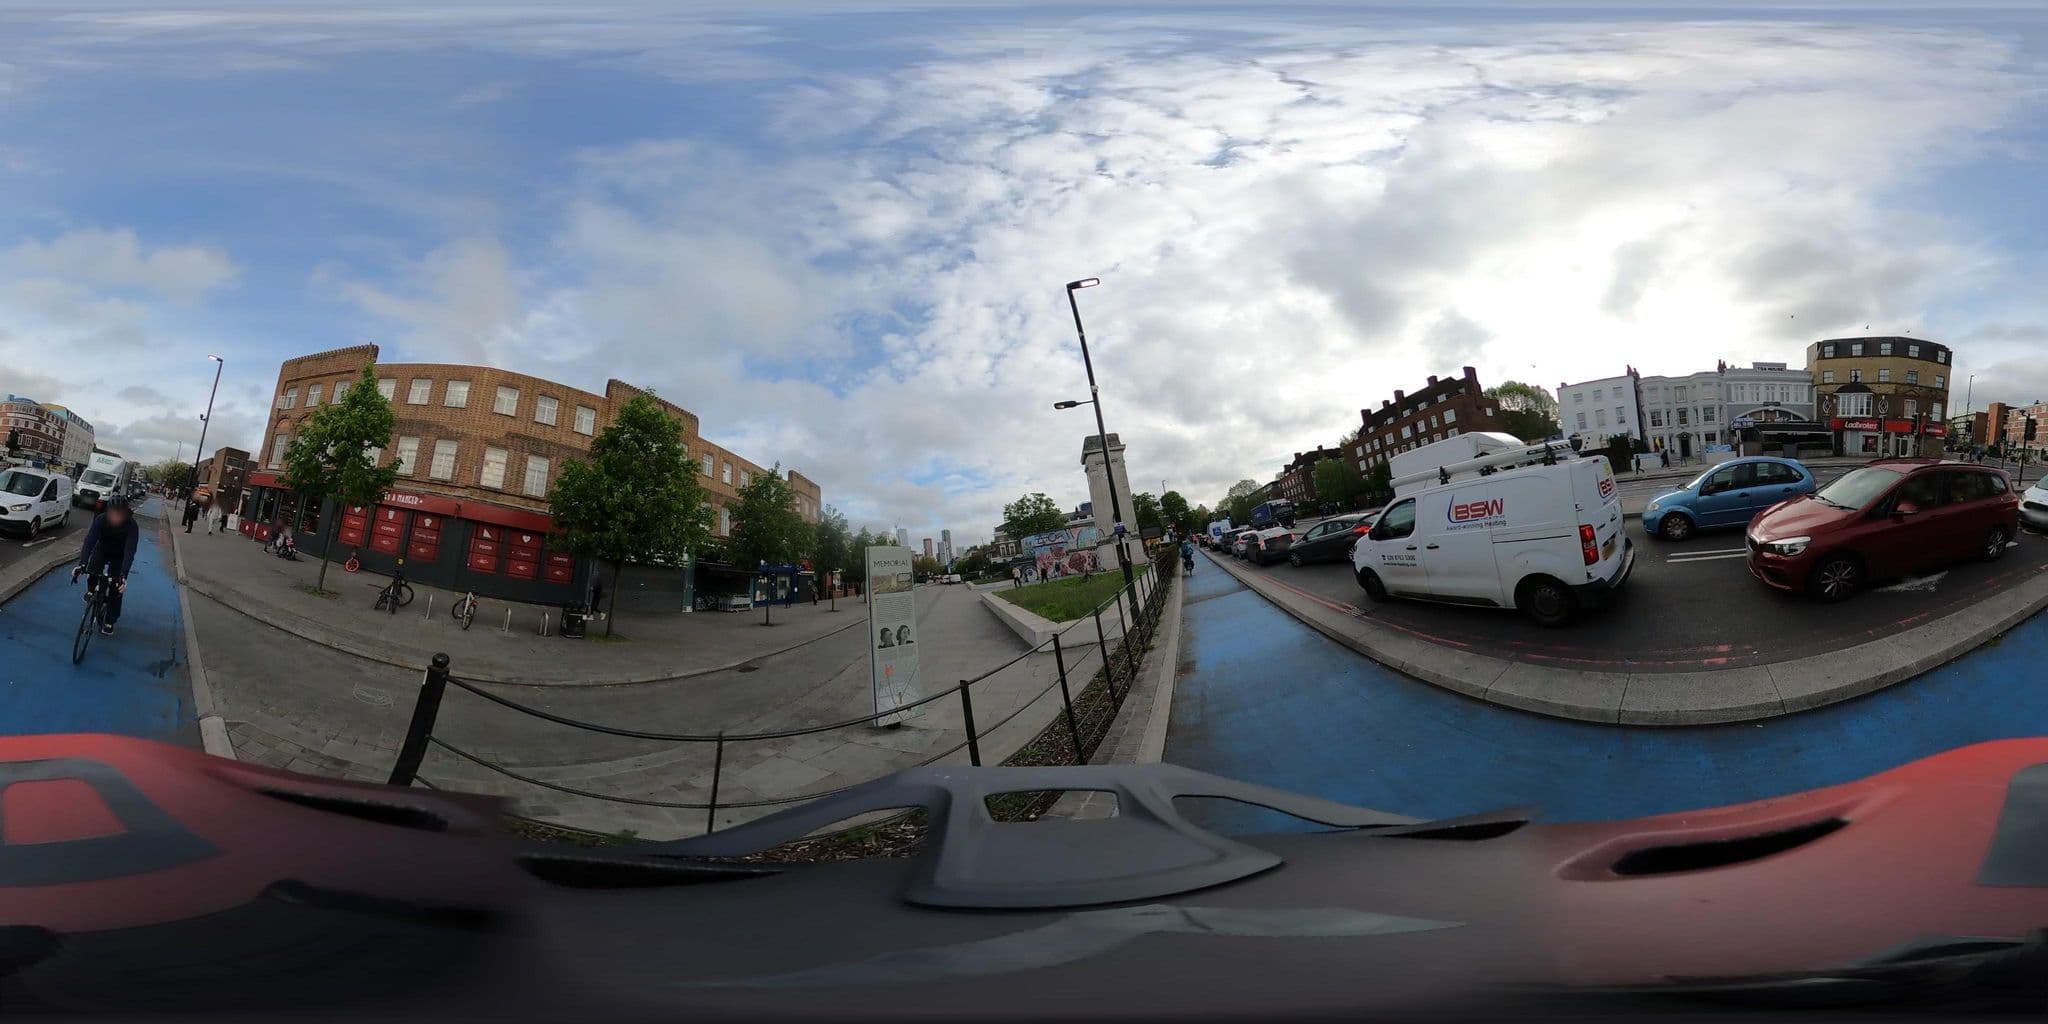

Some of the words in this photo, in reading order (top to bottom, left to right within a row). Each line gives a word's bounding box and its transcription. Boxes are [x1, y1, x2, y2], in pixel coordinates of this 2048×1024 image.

[1844, 420, 1878, 430] Ladbrokes
[1455, 498, 1503, 520] BSW
[873, 559, 908, 568] MEMORIAL
